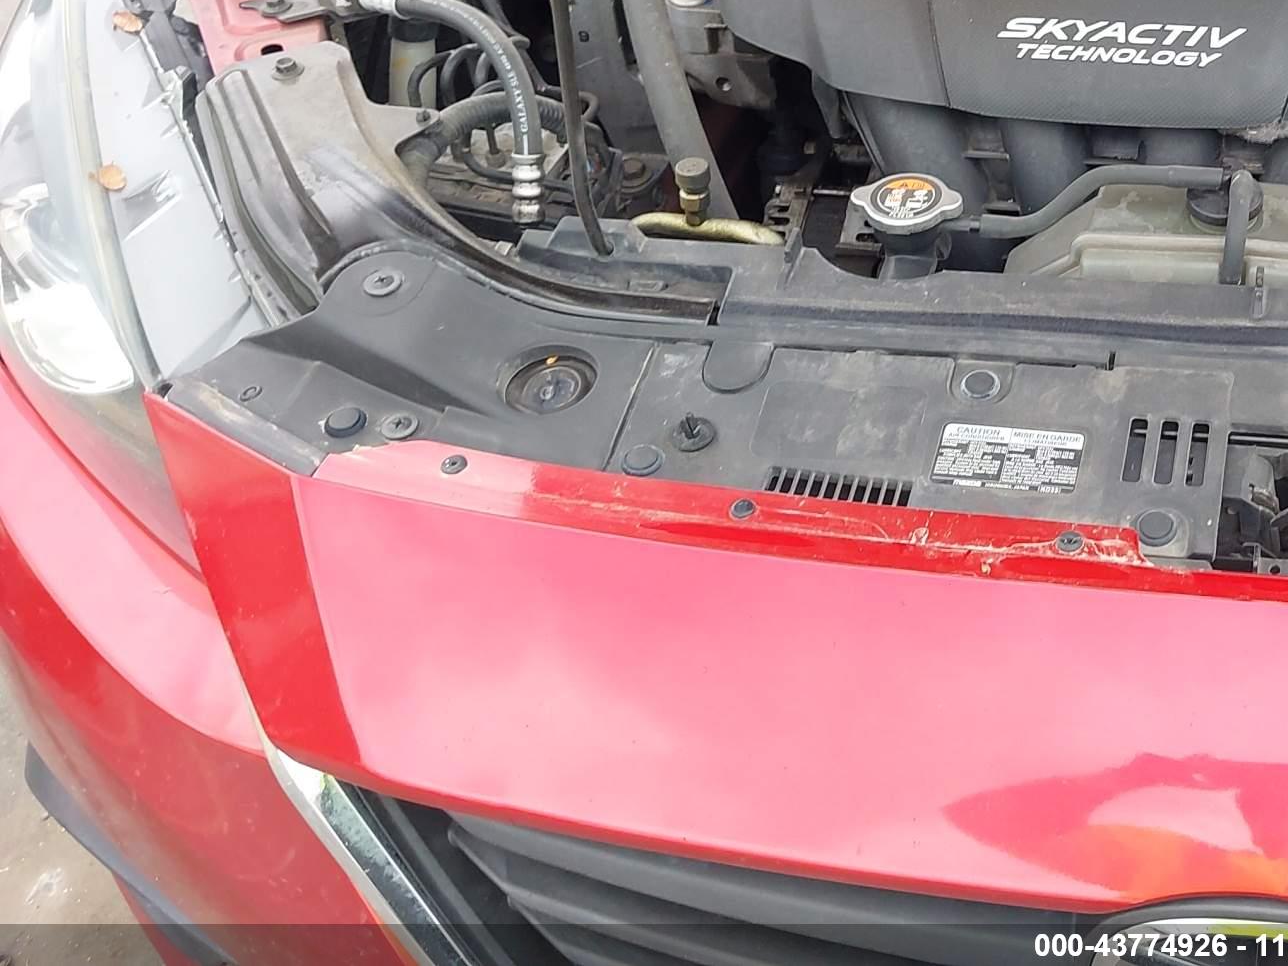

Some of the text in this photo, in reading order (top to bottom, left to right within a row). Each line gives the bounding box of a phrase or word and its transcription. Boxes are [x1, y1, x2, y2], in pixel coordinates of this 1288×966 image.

[996, 17, 1248, 49] SKYACTIV
[1016, 43, 1223, 68] TECHNOLOGY
[957, 426, 1001, 436] CAUTION
